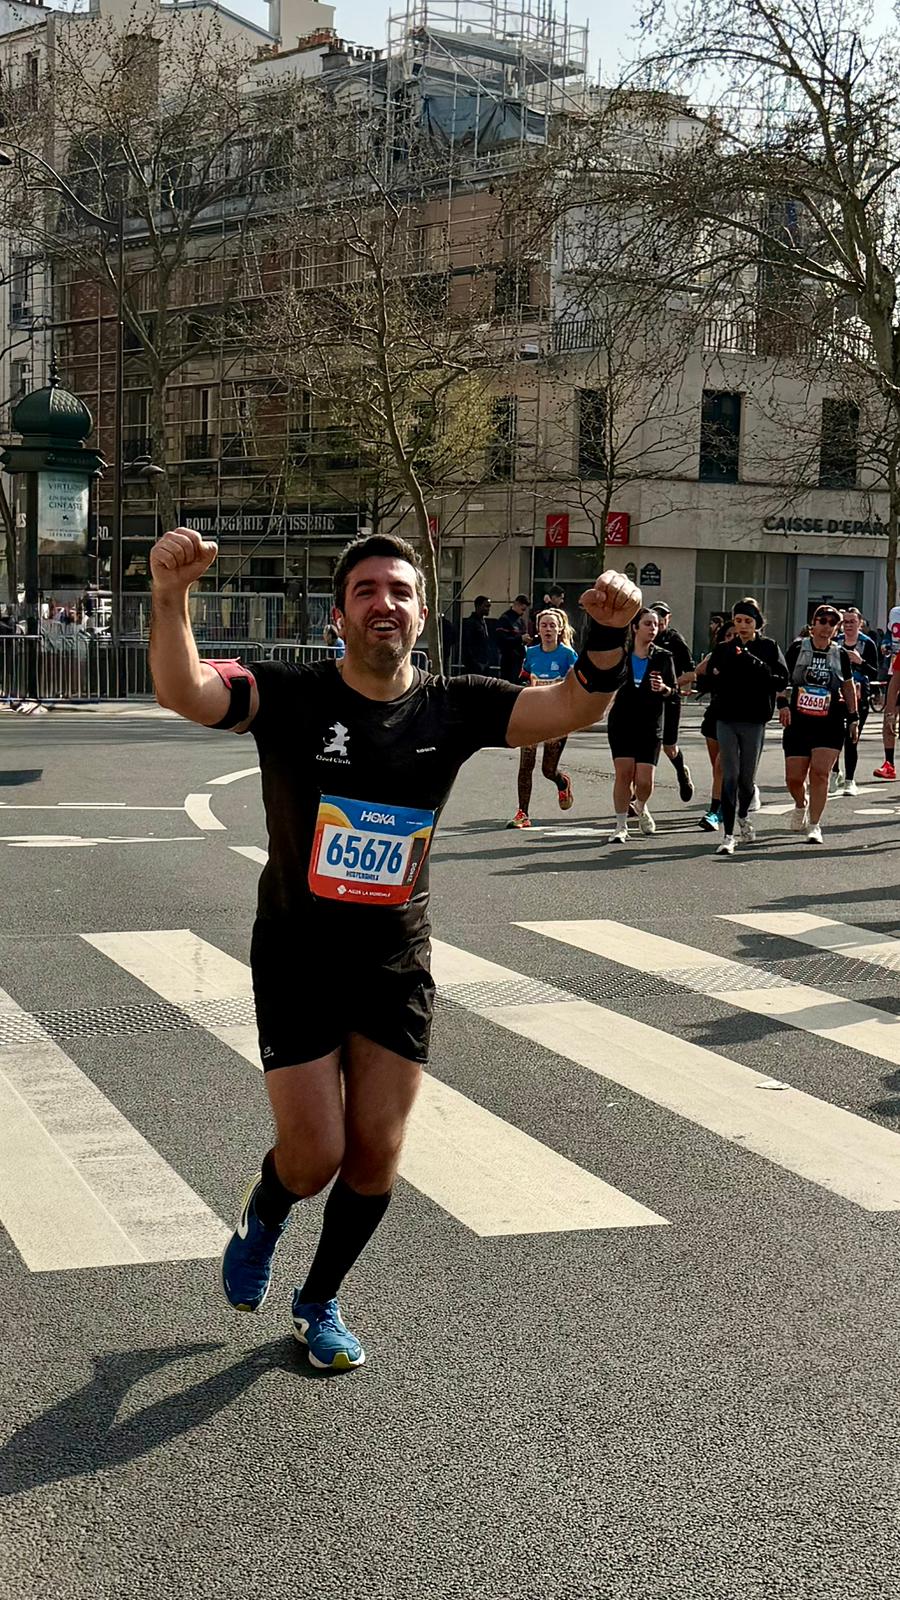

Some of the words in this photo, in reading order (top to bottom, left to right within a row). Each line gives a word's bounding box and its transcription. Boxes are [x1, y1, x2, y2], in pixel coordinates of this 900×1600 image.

[185, 517, 264, 531] BOULANGERIE
[763, 516, 823, 533] CAISSE
[360, 810, 396, 826] HOKA
[326, 833, 403, 874] 65676
